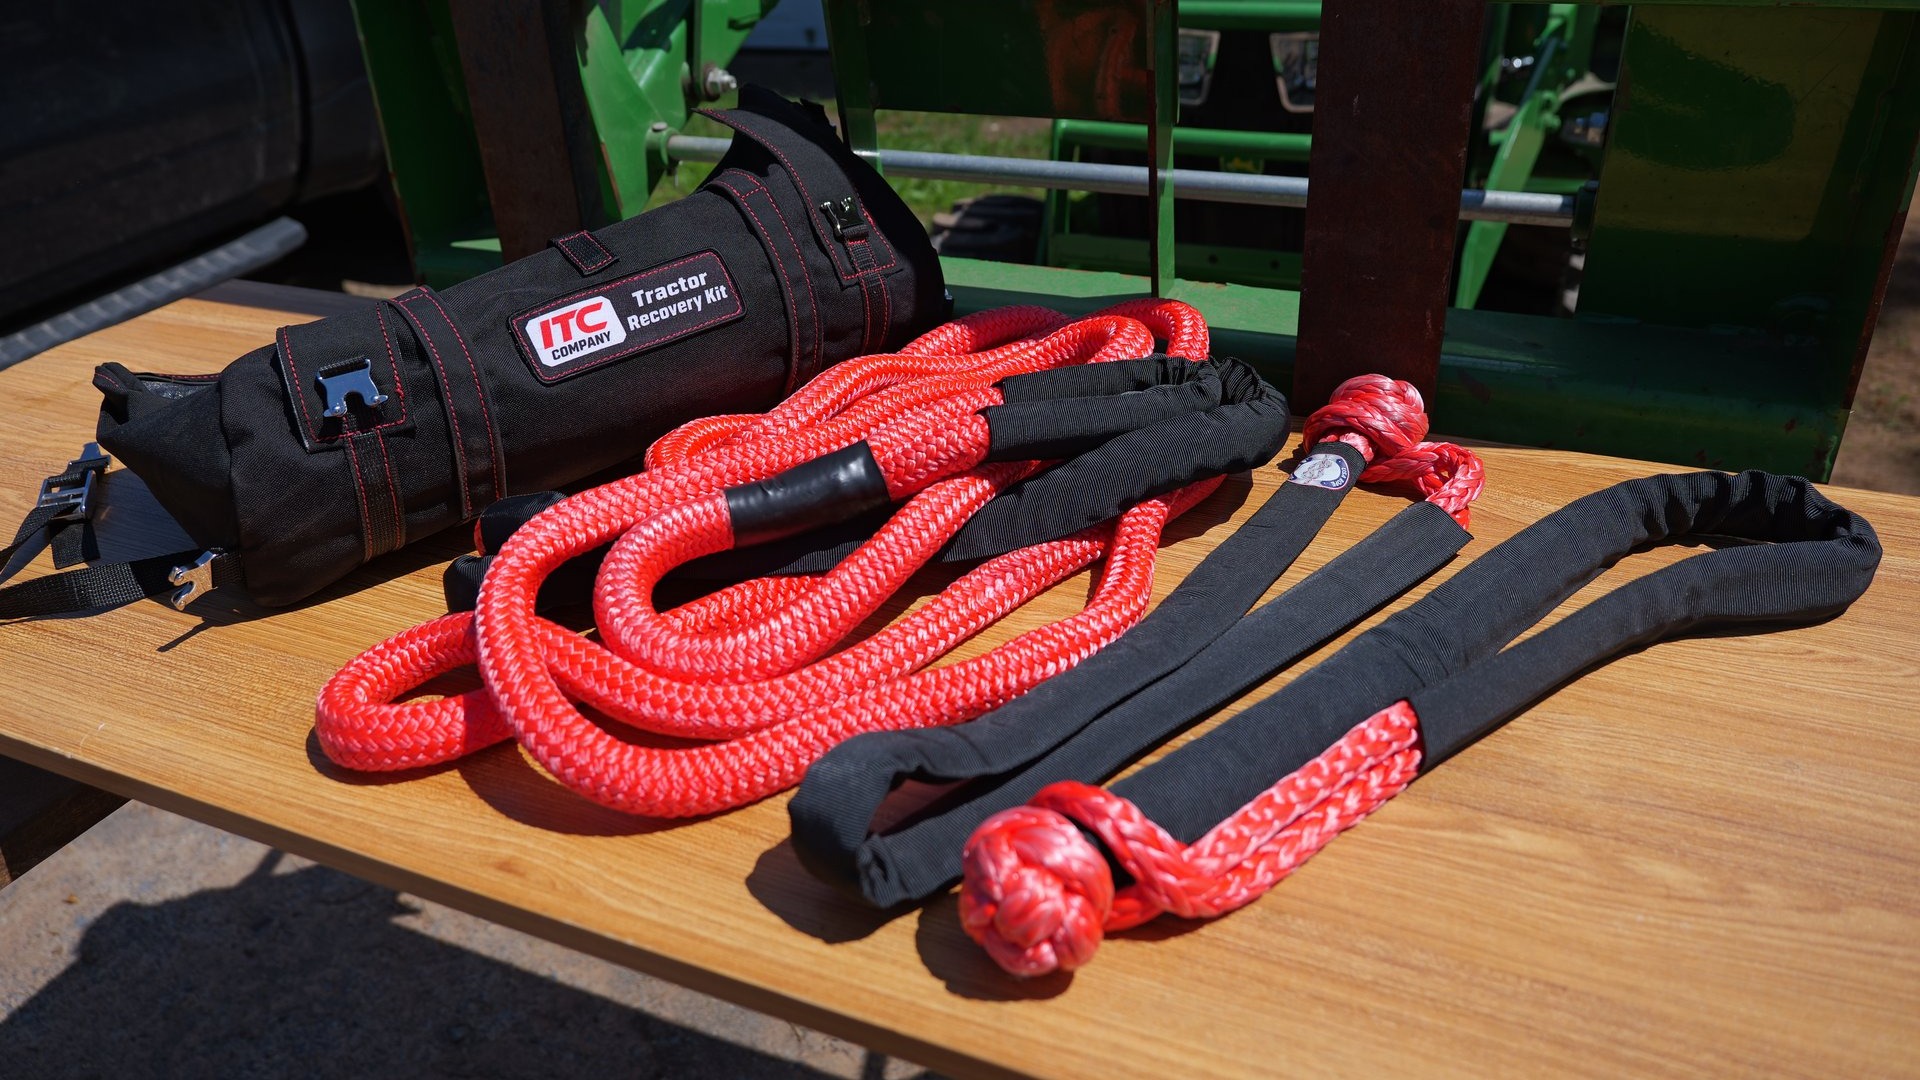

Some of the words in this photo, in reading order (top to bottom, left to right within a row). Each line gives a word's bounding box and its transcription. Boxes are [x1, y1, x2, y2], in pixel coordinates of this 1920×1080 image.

[627, 294, 702, 331] Recovery
[704, 284, 728, 305] Kit
[632, 272, 708, 307] Tractor
[540, 301, 608, 350] ITC
[551, 330, 611, 361] COMPANY
